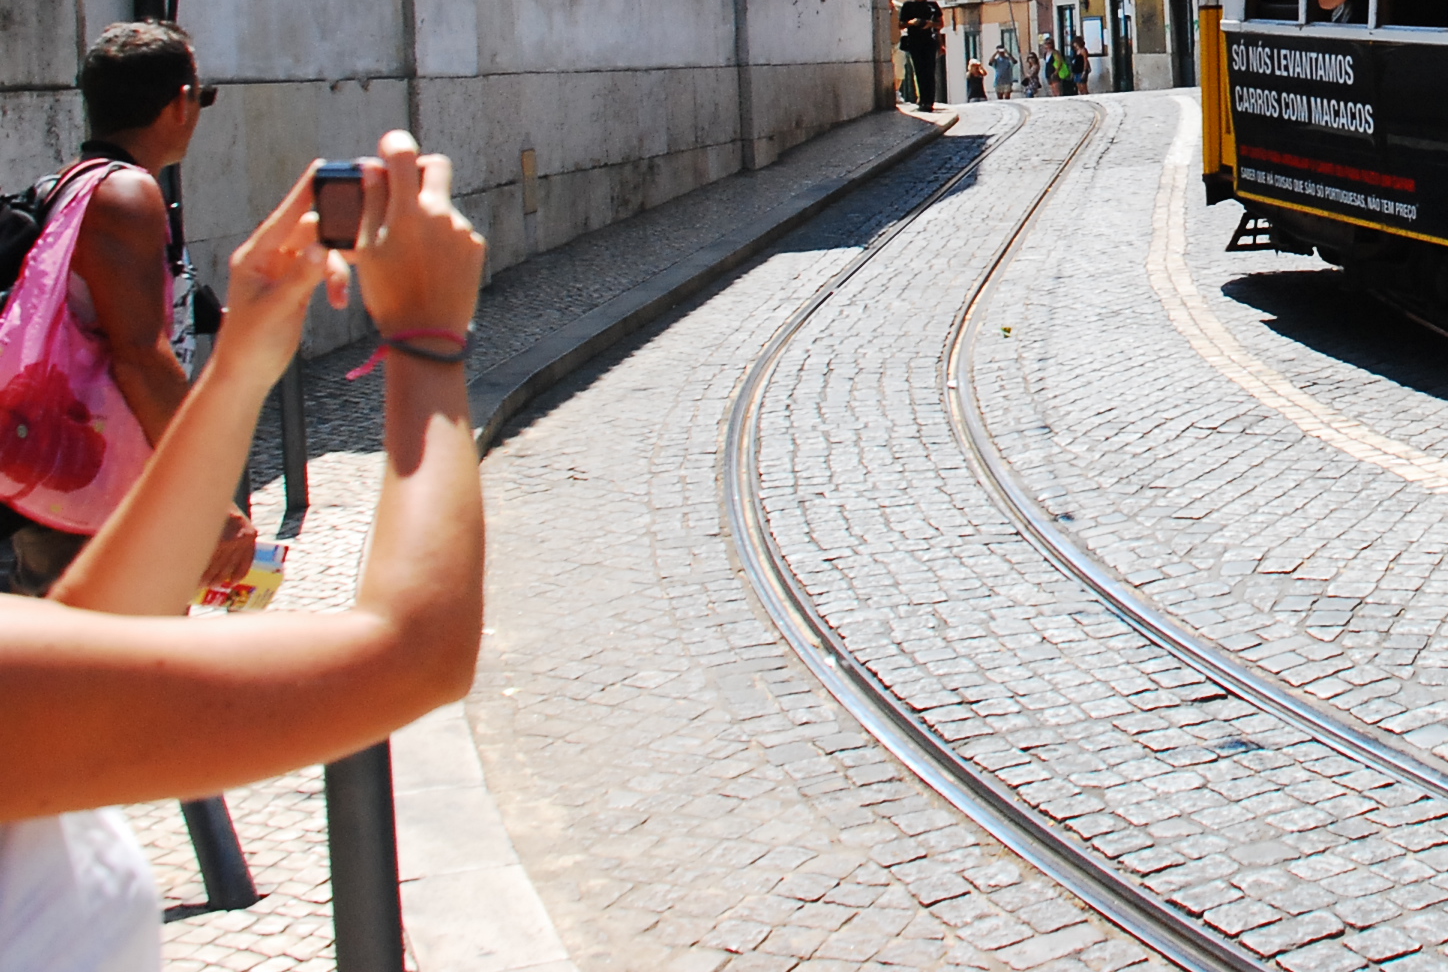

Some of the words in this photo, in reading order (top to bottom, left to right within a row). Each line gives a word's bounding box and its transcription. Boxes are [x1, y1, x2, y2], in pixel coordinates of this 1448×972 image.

[1232, 39, 1246, 71] SÓ
[1249, 40, 1272, 75] NÓS
[1274, 48, 1354, 85] LEVANTAMOS
[1235, 85, 1280, 118] CARROS
[1281, 92, 1309, 123] COM
[1310, 96, 1374, 134] MACACOS
[1381, 199, 1395, 214] TEM
